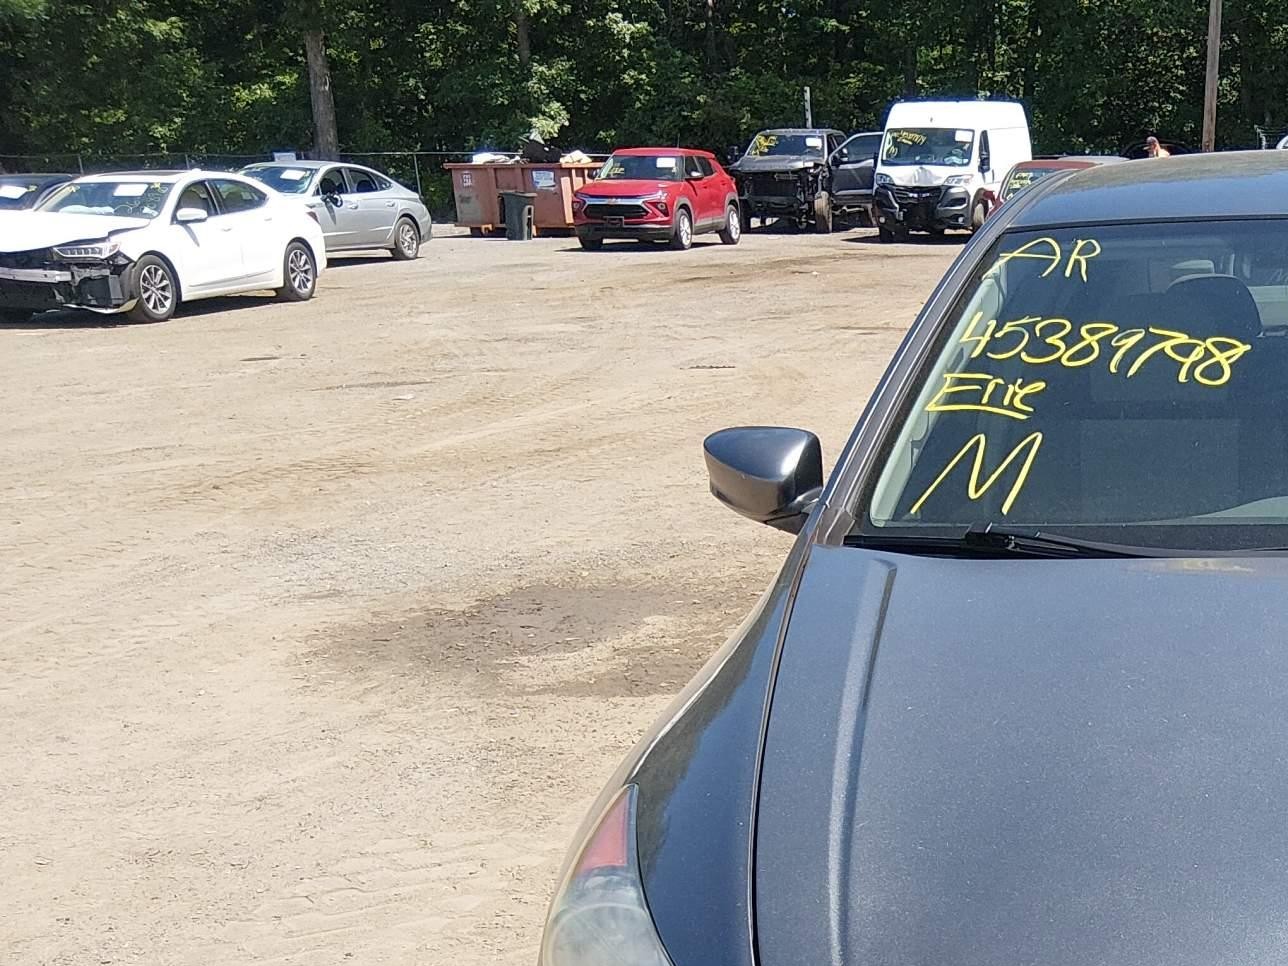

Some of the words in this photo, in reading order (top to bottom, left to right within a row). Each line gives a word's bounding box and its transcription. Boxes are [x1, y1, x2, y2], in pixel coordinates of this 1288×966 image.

[983, 236, 1101, 283] AR
[959, 310, 1252, 386] 45389798
[911, 431, 1043, 515] M
